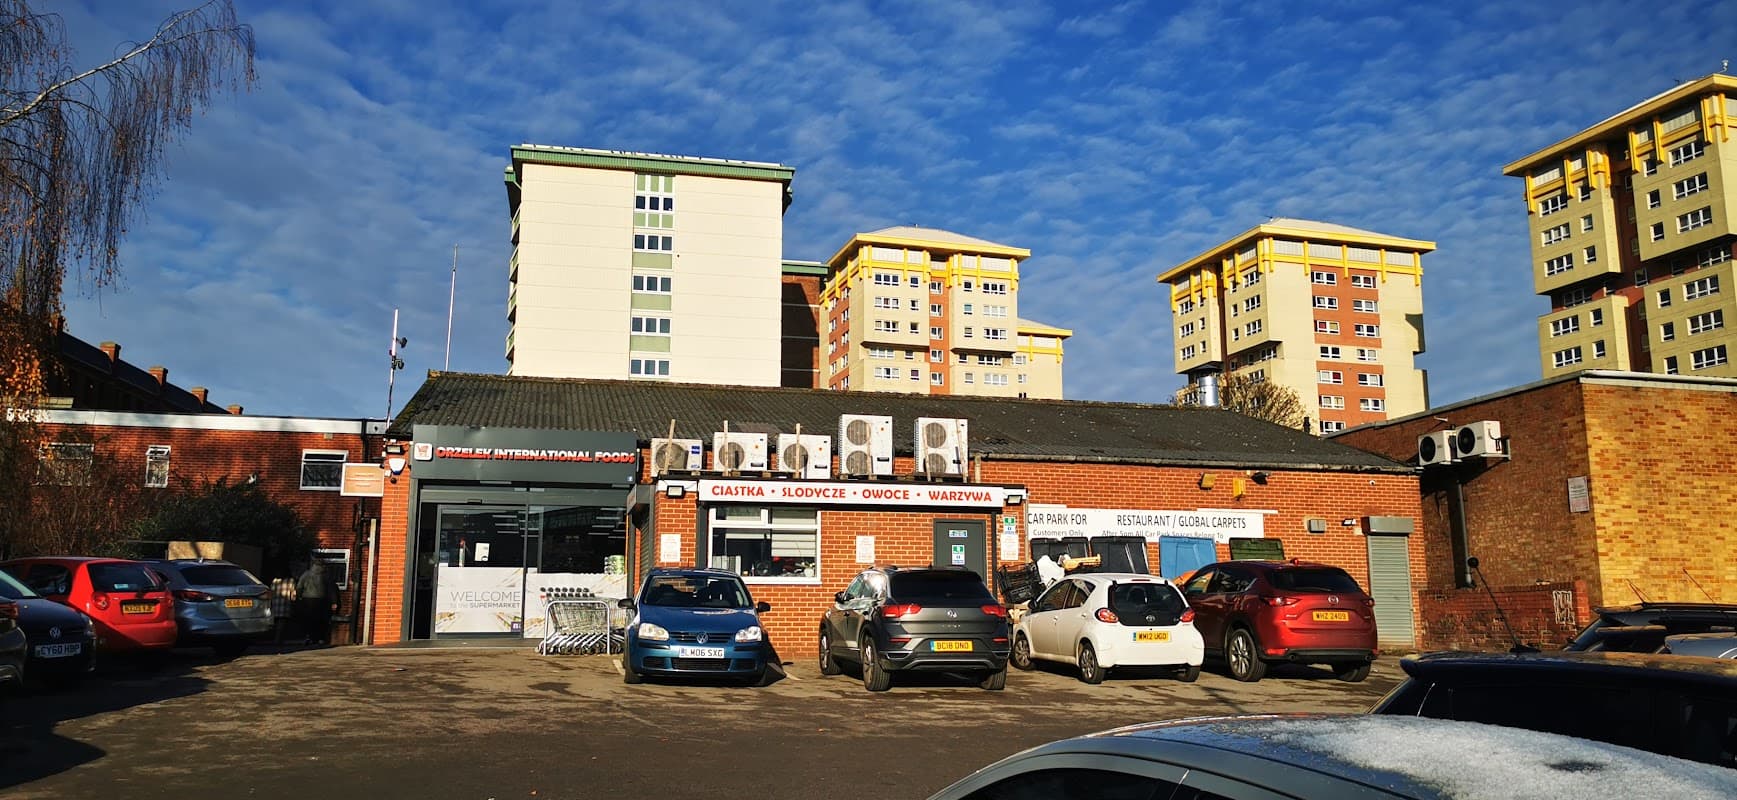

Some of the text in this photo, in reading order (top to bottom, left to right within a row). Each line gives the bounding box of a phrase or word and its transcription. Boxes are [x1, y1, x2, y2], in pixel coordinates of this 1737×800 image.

[435, 446, 635, 464] ORZELEK INTERNATIONAL FOODS
[711, 485, 993, 502] CIASTKA SLODYCZE OWOCE WARZYWA
[1027, 513, 1088, 526] CAR PARK FOR
[1117, 514, 1171, 527] RESTAURANT
[1178, 515, 1210, 528] GLOBAL
[1211, 516, 1247, 529] CARPETS
[1032, 528, 1084, 538] Customers Only
[1144, 530, 1156, 538] Car
[450, 591, 521, 602] WELCOME
